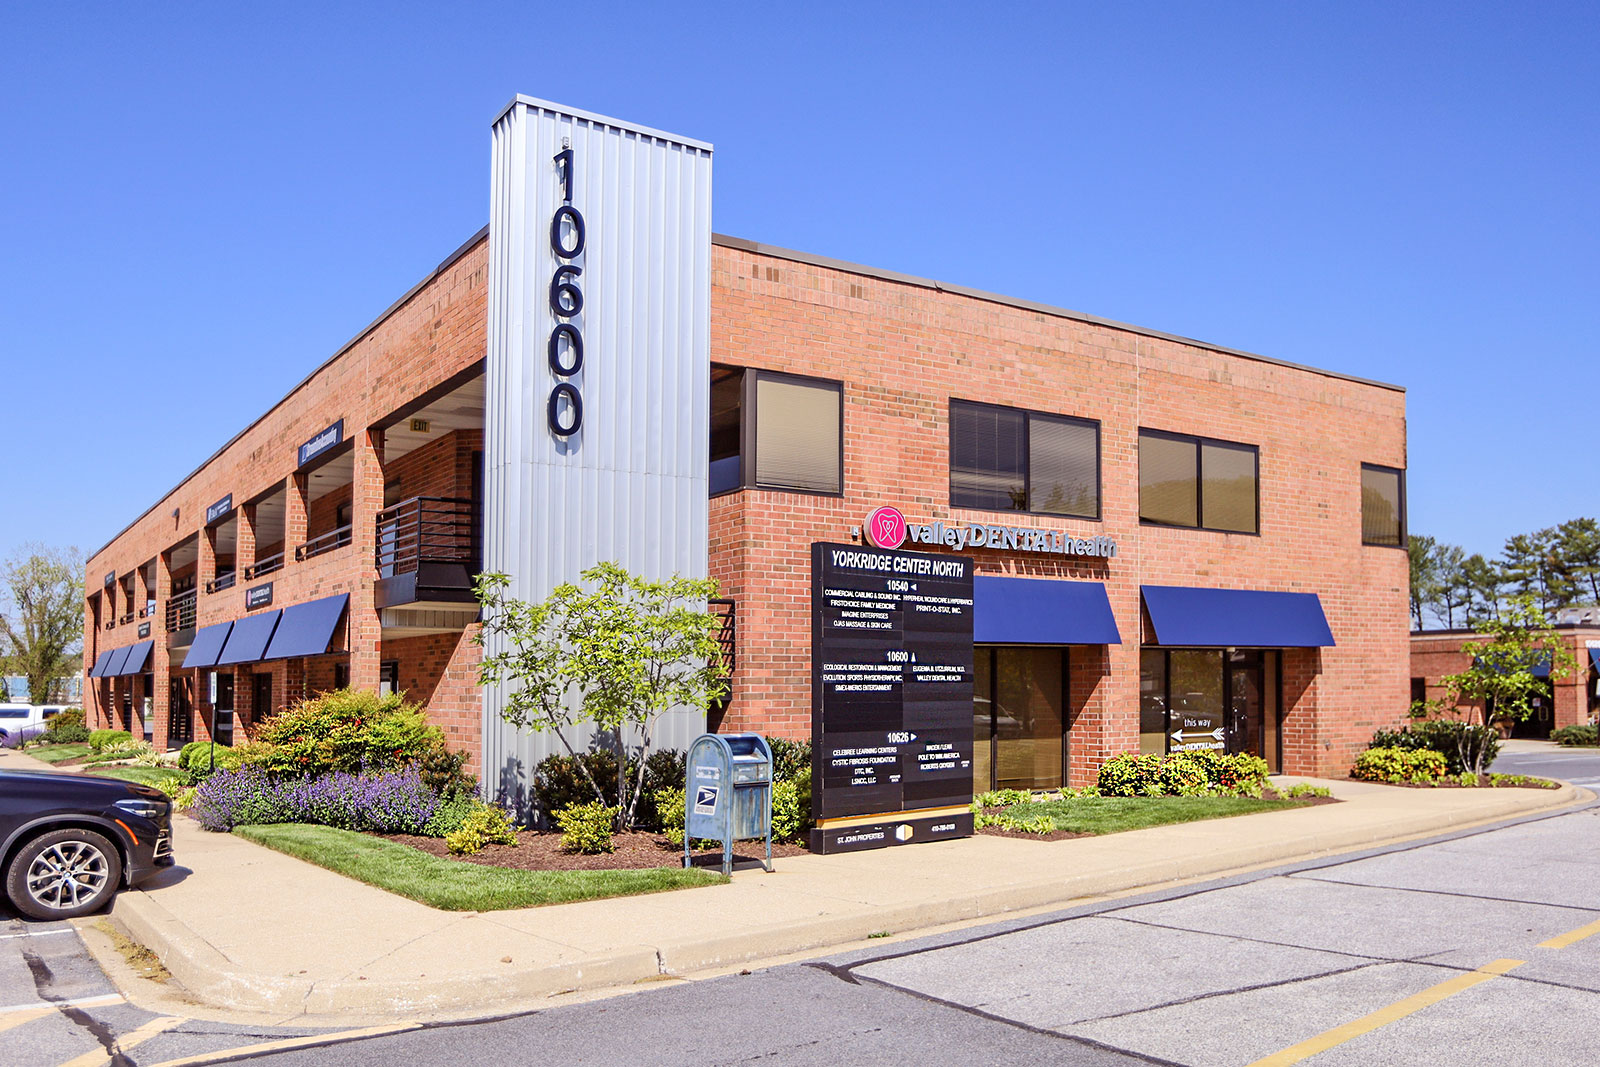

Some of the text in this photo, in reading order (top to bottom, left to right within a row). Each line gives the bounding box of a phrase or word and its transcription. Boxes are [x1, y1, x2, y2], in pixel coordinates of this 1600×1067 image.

[550, 149, 585, 436] 10600
[413, 419, 428, 432] EXIT
[832, 550, 964, 578] YORKRIDGE CENTER NORTH
[887, 579, 909, 592] 10540
[824, 589, 854, 598] COMMERCIAL
[854, 591, 873, 599] CABLING
[916, 604, 951, 614] PRINT-O-STAT,
[860, 611, 889, 620] ENTERPRISES
[881, 622, 893, 630] CARE
[887, 651, 908, 662] 10600
[1184, 719, 1211, 728] this way
[887, 732, 909, 743] 10626
[877, 746, 897, 754] CENTERS
[832, 756, 897, 766] CYSTIC FIBROSIS FOUNDATION
[845, 834, 858, 843] JOHN
[858, 831, 885, 841] PROPERTIES
